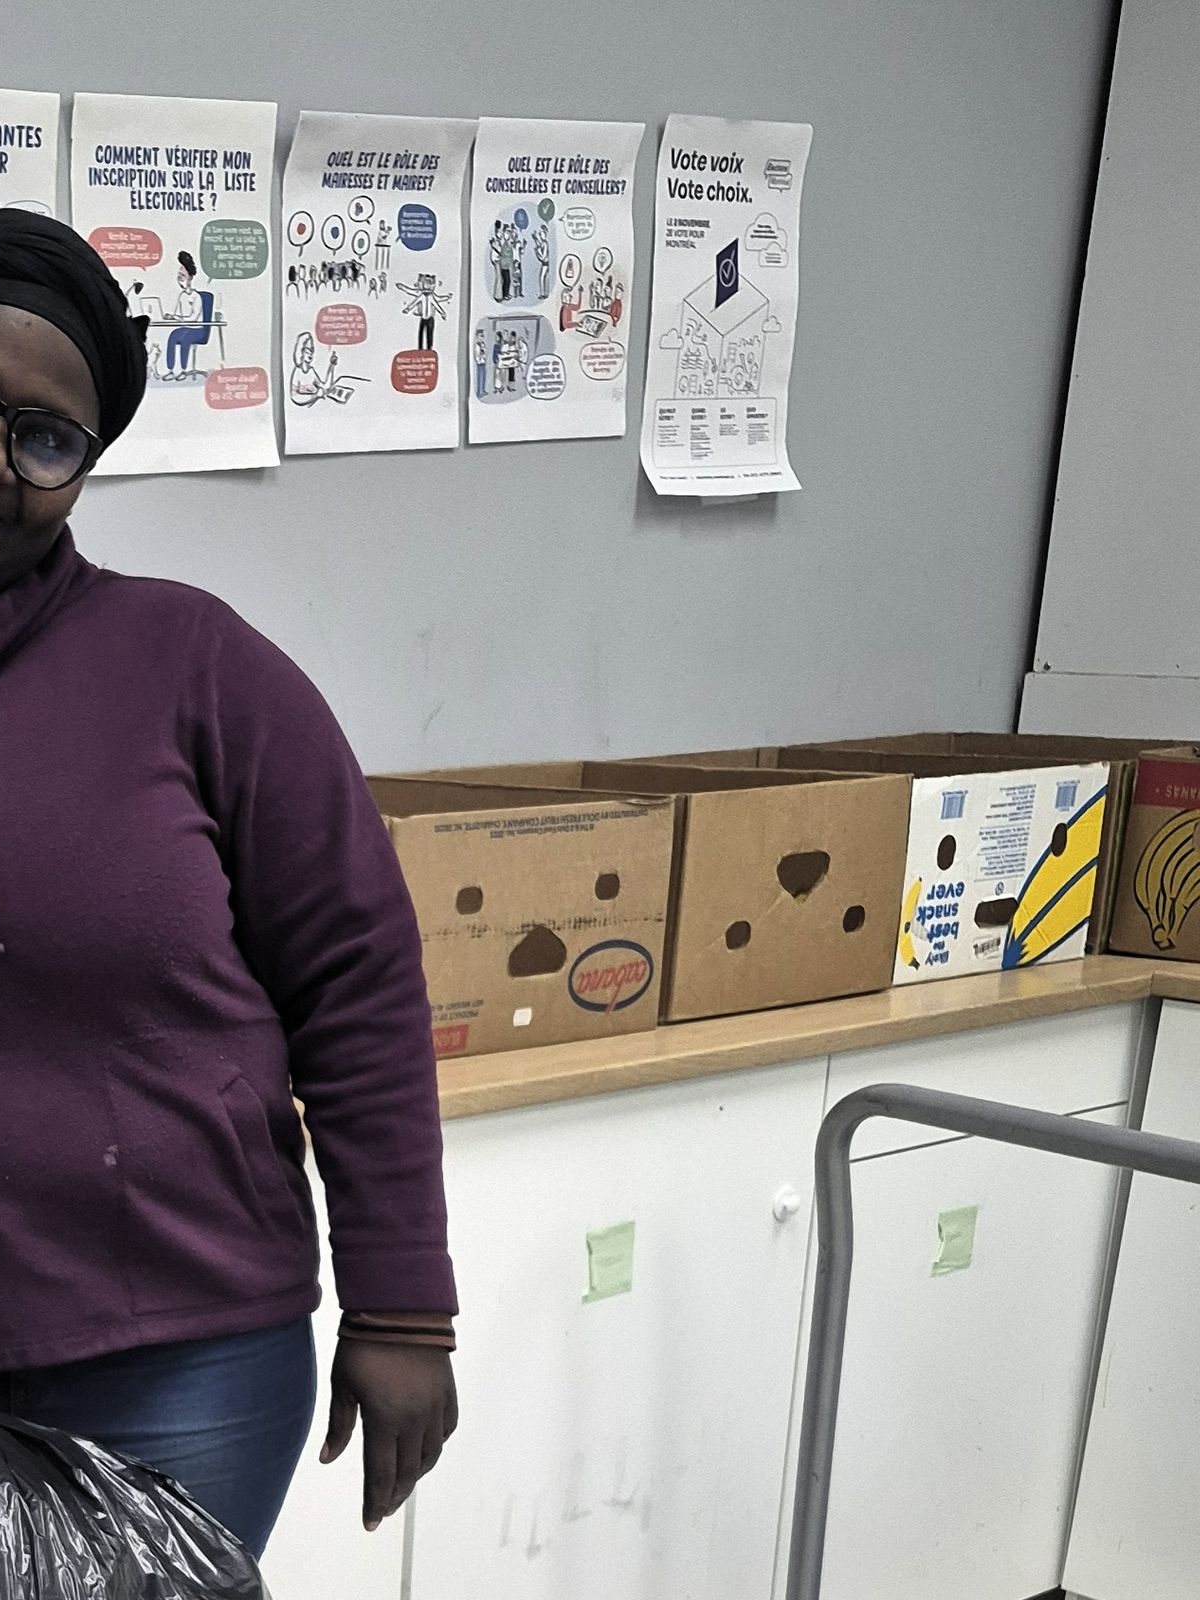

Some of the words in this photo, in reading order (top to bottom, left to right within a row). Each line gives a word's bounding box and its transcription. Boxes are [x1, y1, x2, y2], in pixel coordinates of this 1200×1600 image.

[95, 145, 160, 167] COMMENT
[165, 145, 217, 169] VÉRIFIER
[222, 150, 251, 169] MON
[327, 150, 354, 167] QUEL
[357, 151, 377, 168] EST
[377, 152, 391, 169] LE
[393, 149, 419, 170] RÔLE
[420, 154, 440, 170] DES
[508, 156, 531, 173] QUEL
[535, 157, 552, 173] EST
[553, 157, 566, 174] LE
[567, 154, 591, 174] RÔLE
[592, 159, 610, 174] DES
[671, 147, 707, 171] Vote
[710, 152, 745, 174] voix
[88, 166, 166, 188] INSCRIPTION
[172, 169, 194, 190] SUR
[199, 170, 214, 191] LA
[224, 171, 256, 192] LISTE
[321, 172, 375, 189] MAIRESSES
[377, 173, 391, 190] ET
[392, 174, 435, 191] MAIRES?
[485, 175, 549, 194] CONSEILLÈRES
[551, 178, 562, 194] ET
[565, 179, 627, 195] CONSEILLERS?
[130, 187, 205, 211] ÉLECTORALE
[667, 177, 704, 201] Vote
[706, 180, 753, 204] choix.
[927, 881, 965, 900] ever
[916, 902, 959, 925] snack
[927, 921, 960, 943] best
